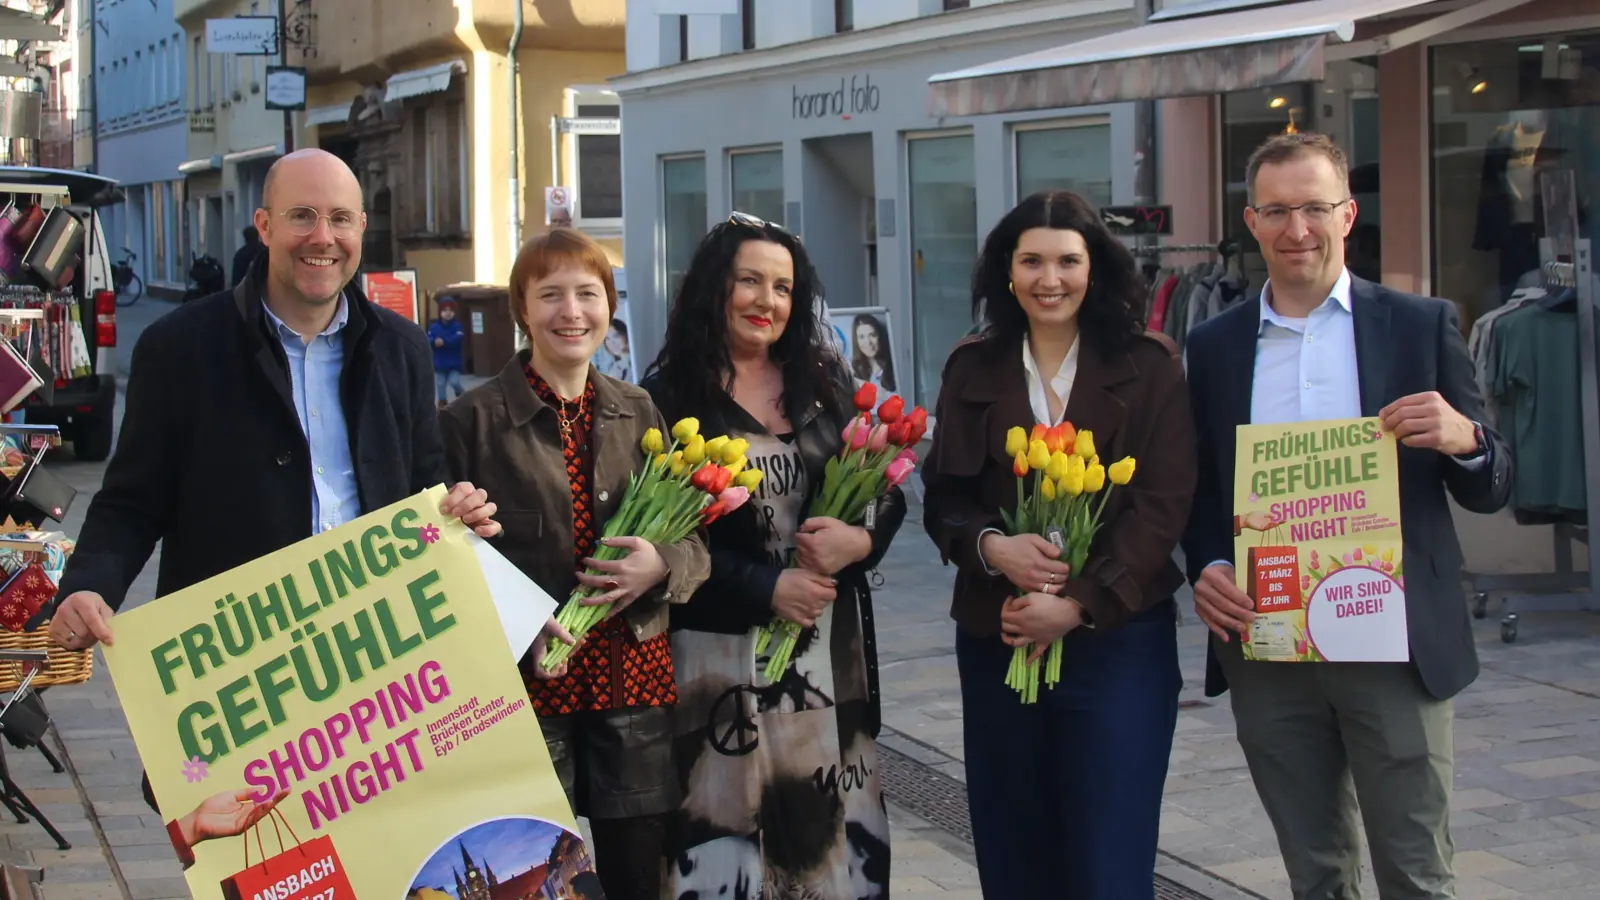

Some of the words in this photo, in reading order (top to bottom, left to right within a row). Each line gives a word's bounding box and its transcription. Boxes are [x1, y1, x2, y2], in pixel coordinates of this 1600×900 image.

[1253, 421, 1376, 464] FRÜHLINGS
[1252, 451, 1379, 498] GEFÜHLE
[1270, 490, 1366, 523] SHOPPING
[1290, 517, 1347, 543] NIGHT
[1257, 555, 1296, 566] ANSBACH
[1260, 571, 1267, 579] 7.
[1269, 568, 1292, 578] MÄRZ
[150, 508, 429, 696] FRÜHLINGS
[1261, 597, 1271, 606] 22
[1273, 595, 1290, 604] UHR
[1269, 583, 1283, 592] BIS
[1325, 585, 1353, 602] WIR
[1357, 580, 1392, 598] SIND
[1336, 599, 1383, 618] DABEI!
[177, 569, 458, 766] GEFÜHLE
[243, 660, 451, 803] SHOPPING
[426, 696, 480, 734] Innenstadt
[430, 716, 472, 745] Brücken
[473, 696, 505, 720] Center
[434, 740, 454, 757] Eyb
[461, 699, 525, 741] Brodswinden
[301, 728, 426, 830] NIGHT
